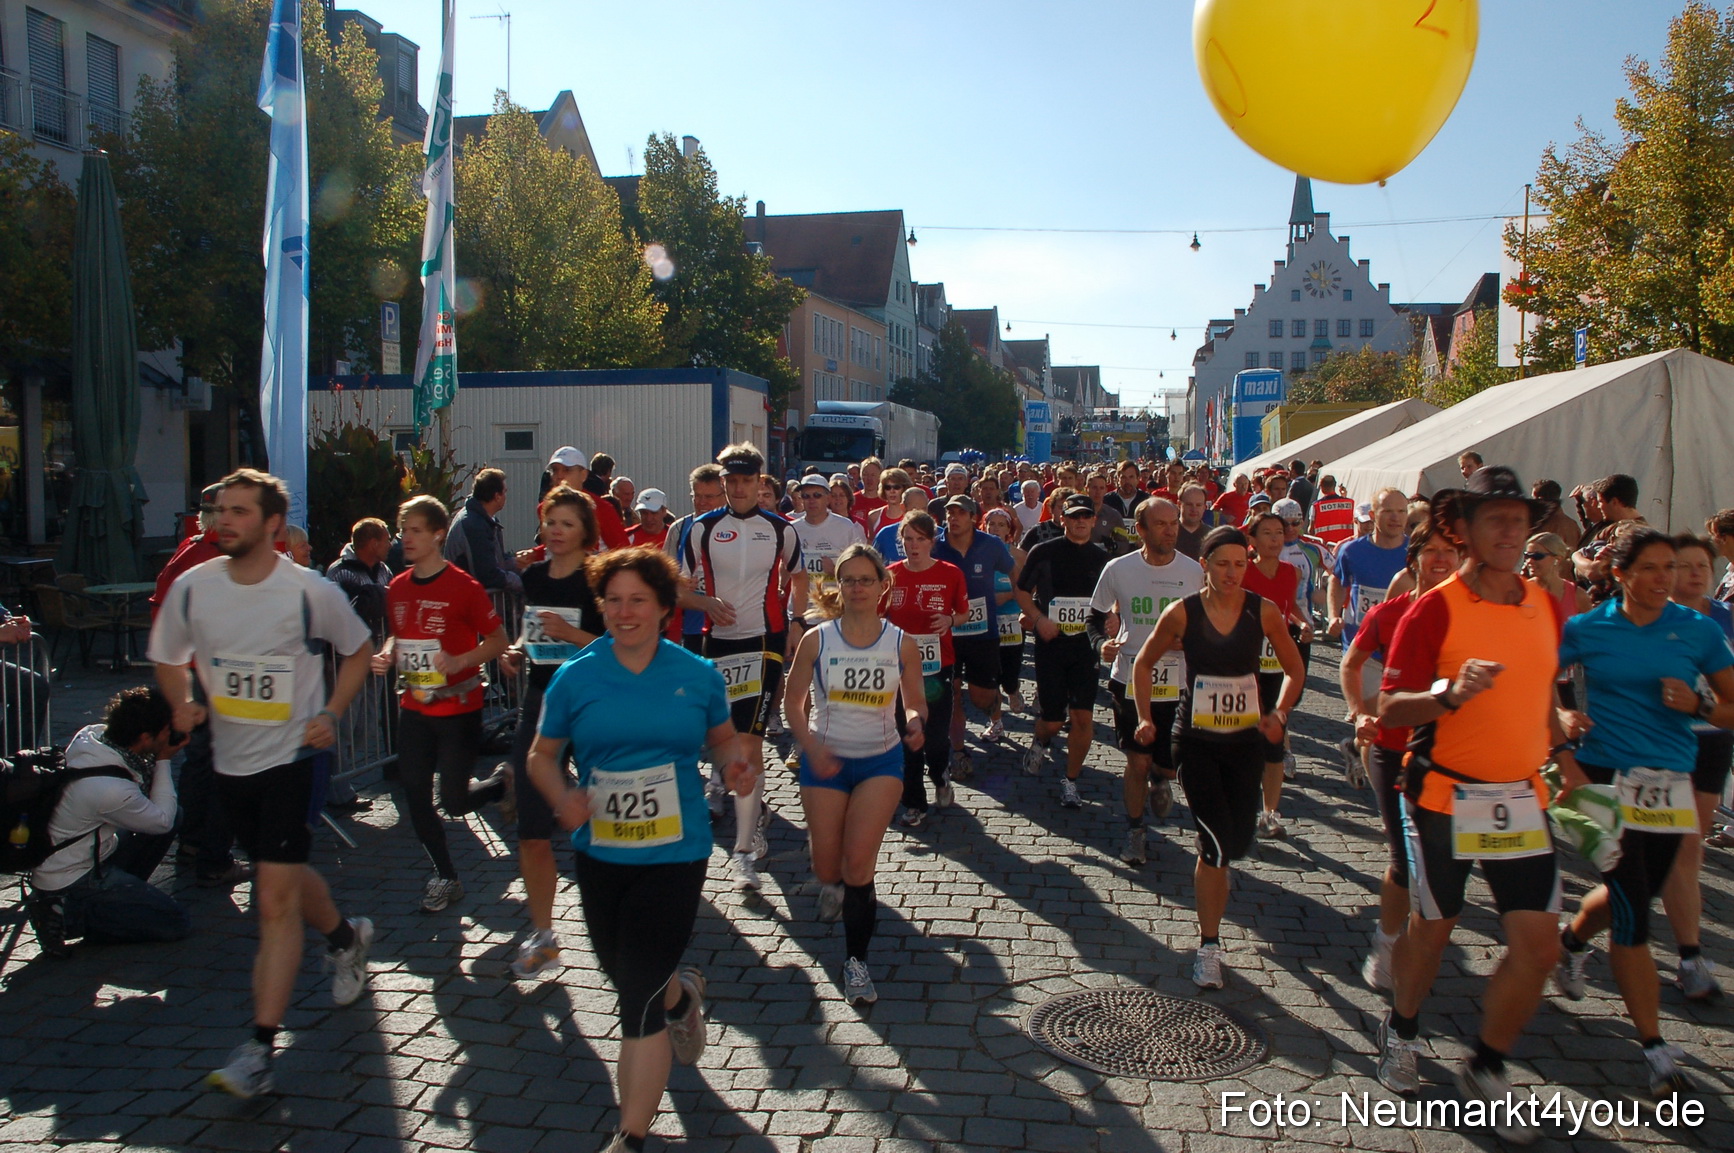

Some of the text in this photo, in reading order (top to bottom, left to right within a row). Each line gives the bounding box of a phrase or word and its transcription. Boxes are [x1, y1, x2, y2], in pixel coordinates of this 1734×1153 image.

[385, 306, 395, 335] P
[1577, 333, 1584, 358] P
[1244, 377, 1278, 396] maxi
[716, 531, 731, 539] tkn
[968, 606, 983, 622] 23
[1058, 607, 1086, 623] 684
[1131, 596, 1153, 614] GO
[1000, 623, 1013, 635] 41
[402, 652, 431, 671] 734
[226, 671, 275, 700] 918
[722, 664, 751, 686] 377
[844, 667, 885, 690] 828
[758, 691, 771, 722] SKINS
[841, 690, 884, 705] Andrea
[1208, 692, 1247, 714] 198
[1213, 714, 1240, 726] Nina
[606, 788, 660, 820] 425
[1493, 803, 1509, 831] 9
[613, 820, 658, 841] Birgit
